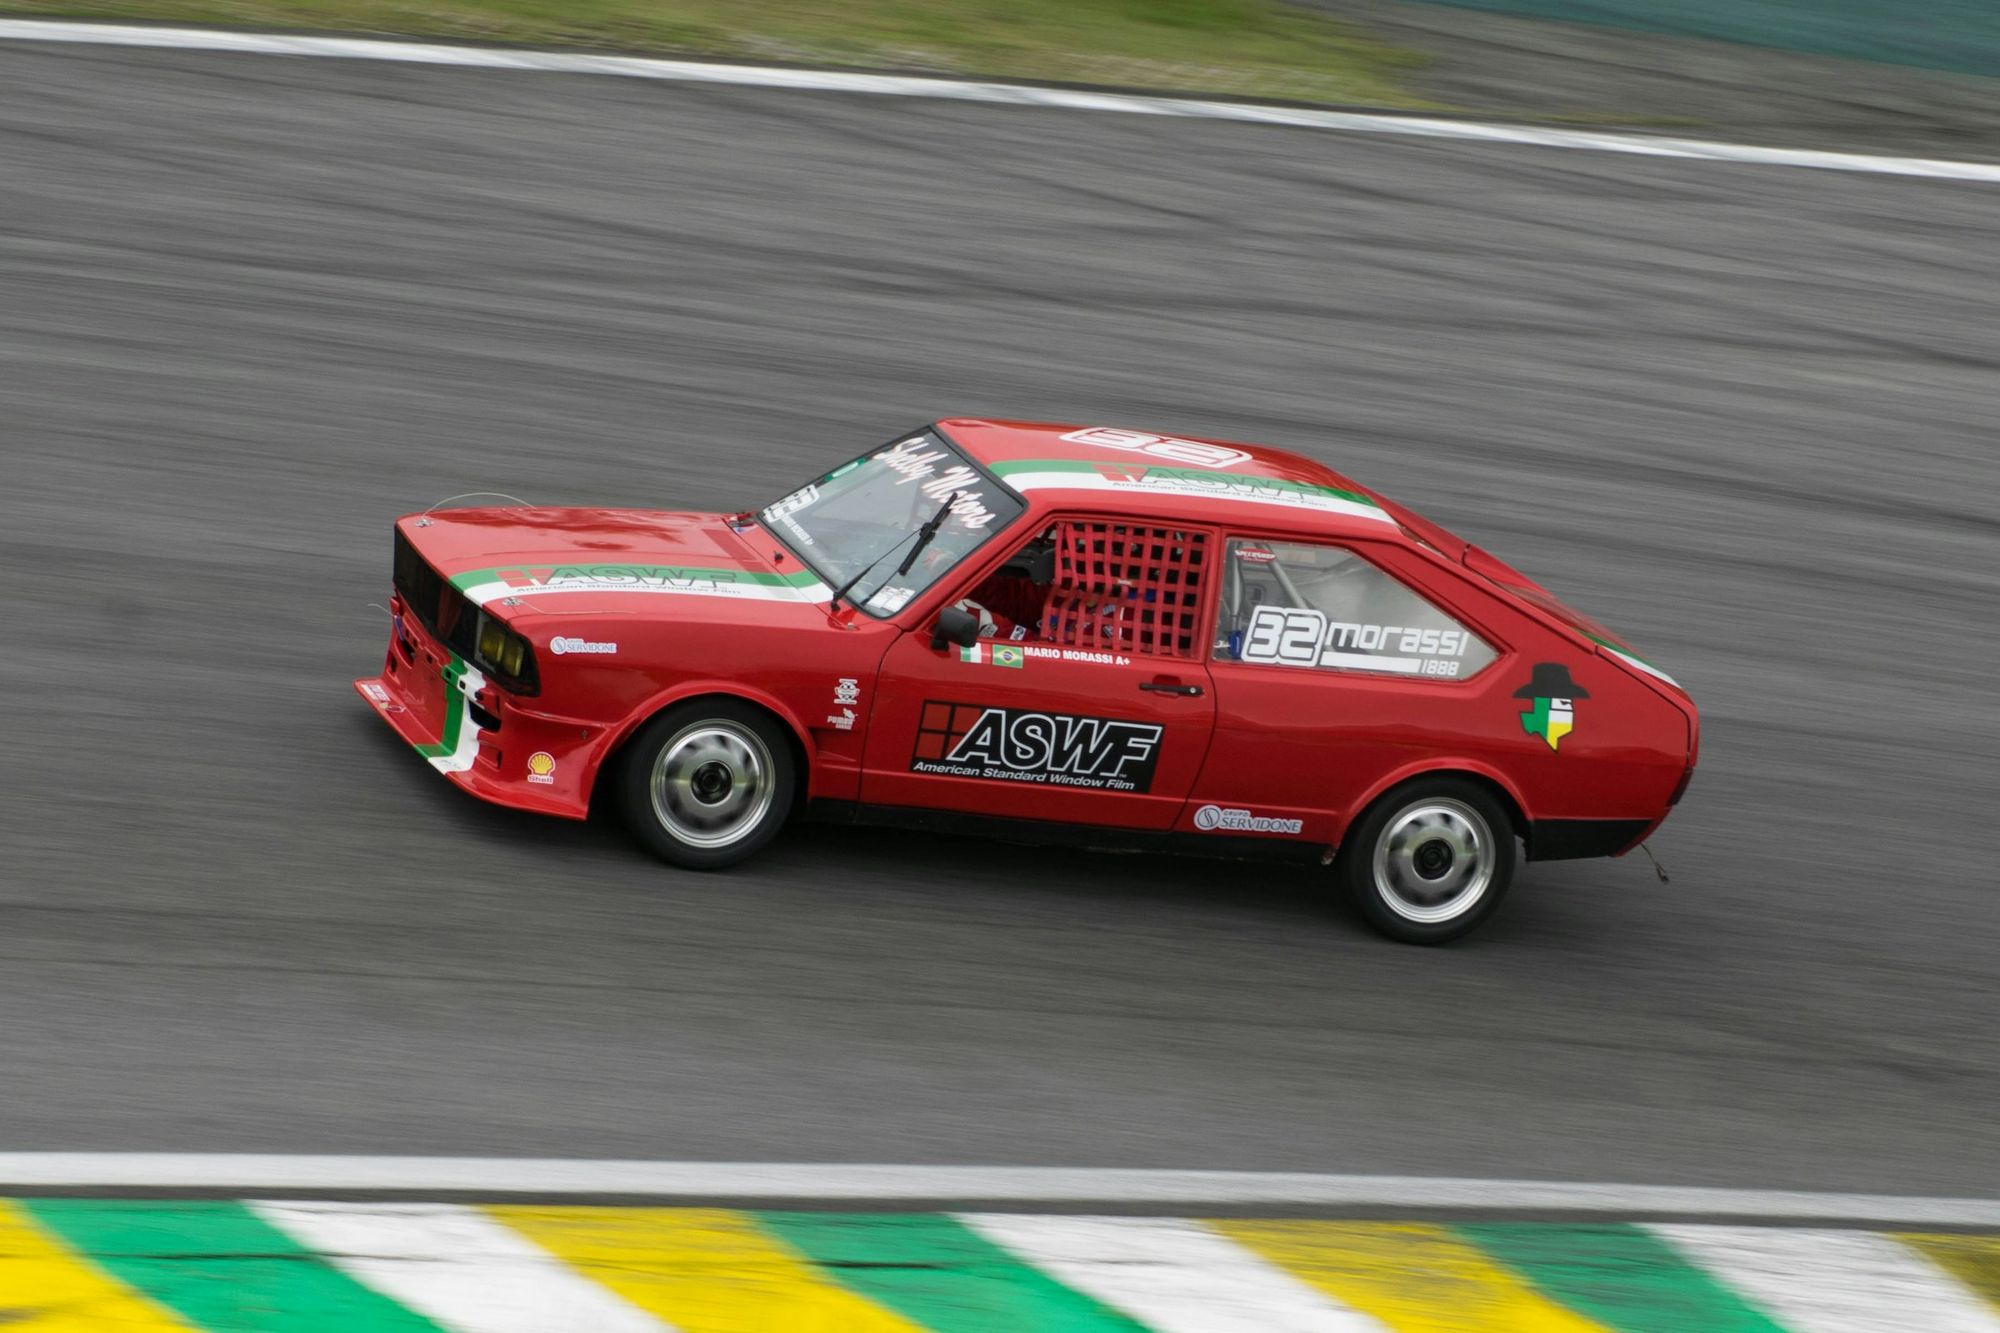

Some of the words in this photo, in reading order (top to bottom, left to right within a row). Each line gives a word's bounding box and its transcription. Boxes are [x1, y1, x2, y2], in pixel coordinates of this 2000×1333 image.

[543, 566, 737, 589] ASWF
[1247, 611, 1323, 660] 32
[566, 642, 616, 652] SERVIDONE
[1024, 646, 1061, 659] MARIO
[1063, 649, 1113, 664] MORASSI
[1115, 655, 1131, 666] A+
[1421, 658, 1460, 676] 1888
[946, 708, 1163, 778] ASWF
[529, 775, 553, 784] Shell
[913, 761, 980, 777] American
[982, 767, 1047, 783] Standard
[1050, 773, 1104, 788] Window
[1106, 778, 1136, 791] Film
[1220, 817, 1301, 832] SERVIDONE
